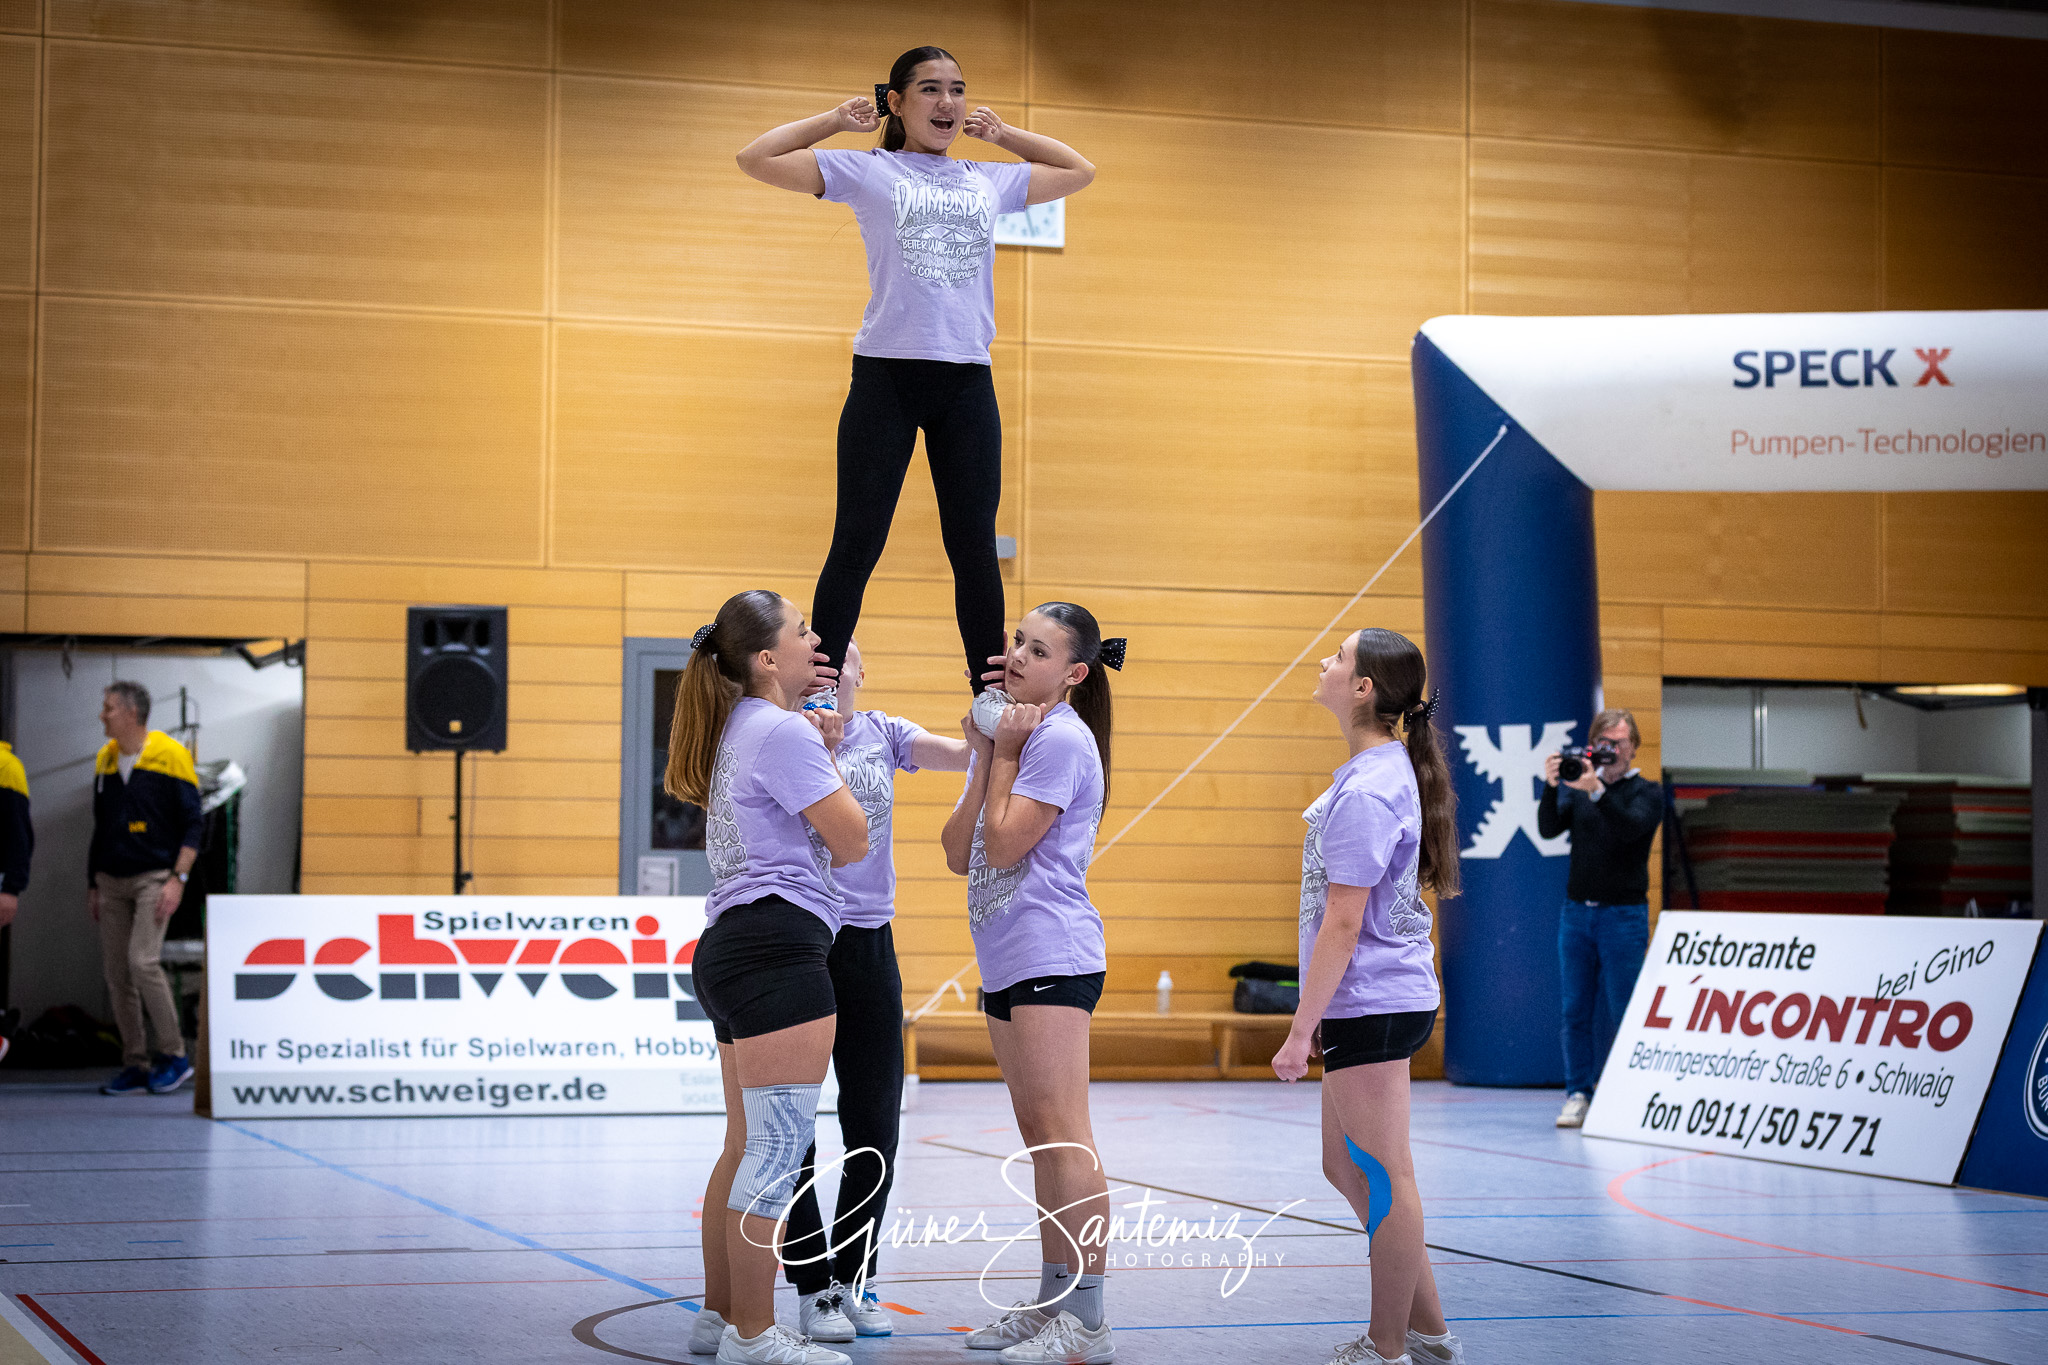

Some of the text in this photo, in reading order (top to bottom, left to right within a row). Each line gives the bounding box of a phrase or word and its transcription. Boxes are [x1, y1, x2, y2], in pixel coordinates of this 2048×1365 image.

[892, 179, 991, 232] DIAMONDS
[902, 239, 928, 250] BETTER
[1733, 349, 1899, 388] SPECK
[1731, 428, 2046, 459] Pumpen-Technologien
[423, 911, 629, 935] Spielwaren
[1667, 932, 1816, 971] Ristorante
[1874, 940, 1995, 1003] bei Gino
[230, 1038, 267, 1060] Ihr
[276, 1038, 413, 1064] Spezialist
[420, 1038, 458, 1060] für
[468, 1038, 627, 1064] Spielwaren,
[232, 1078, 607, 1107] www.schweiger.de
[1629, 1042, 1954, 1107] Behringersdorfer Straße 6 Schwaig
[1641, 1093, 1682, 1131] fon
[1686, 1099, 1797, 1149] 0911/50
